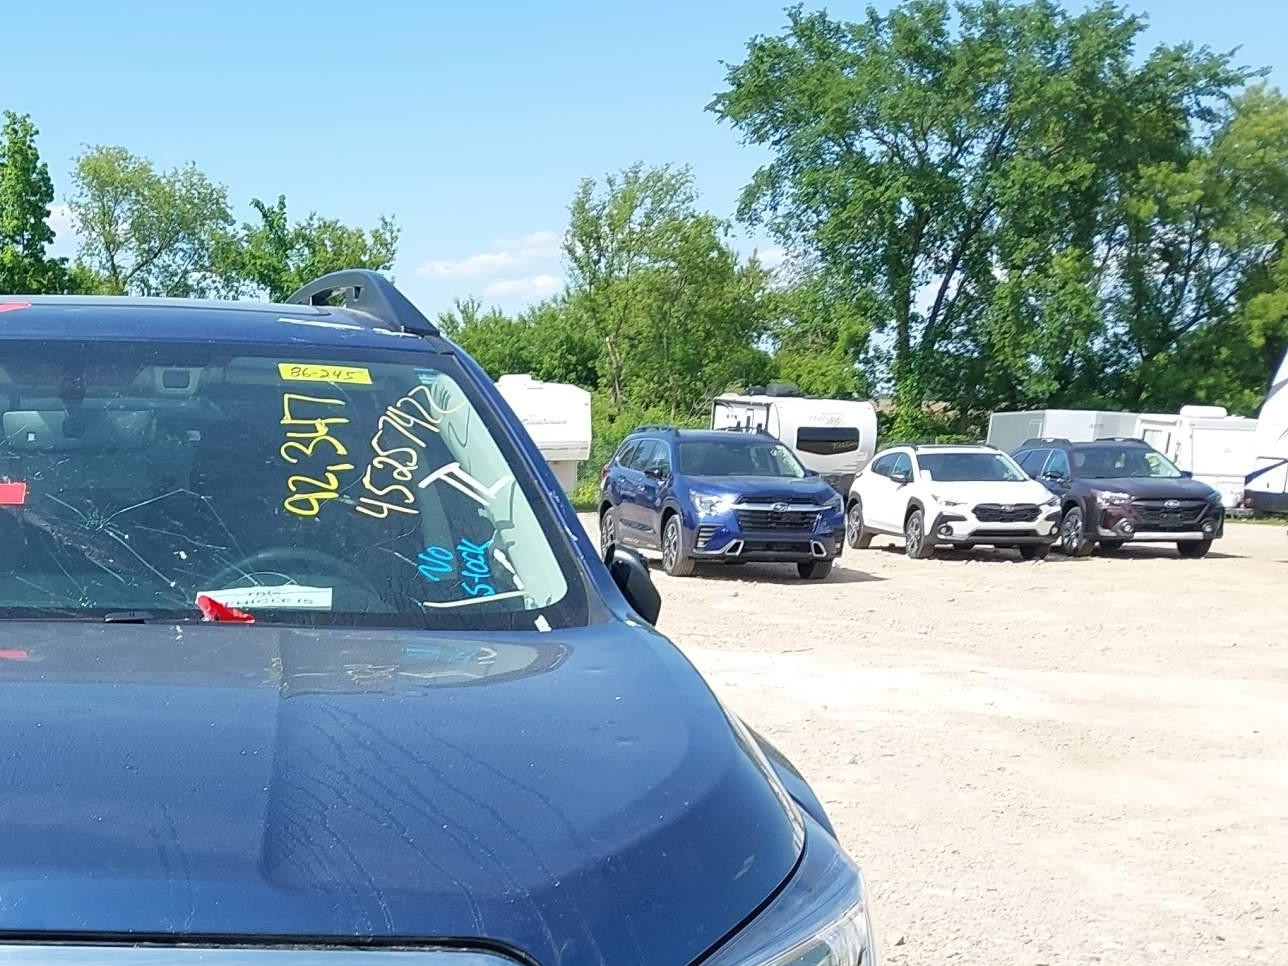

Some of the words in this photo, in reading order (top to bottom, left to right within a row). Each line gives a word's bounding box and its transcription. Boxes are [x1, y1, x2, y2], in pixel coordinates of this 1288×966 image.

[289, 366, 357, 381] 86-245
[280, 393, 355, 516] 92,347
[355, 385, 466, 519] 45257422
